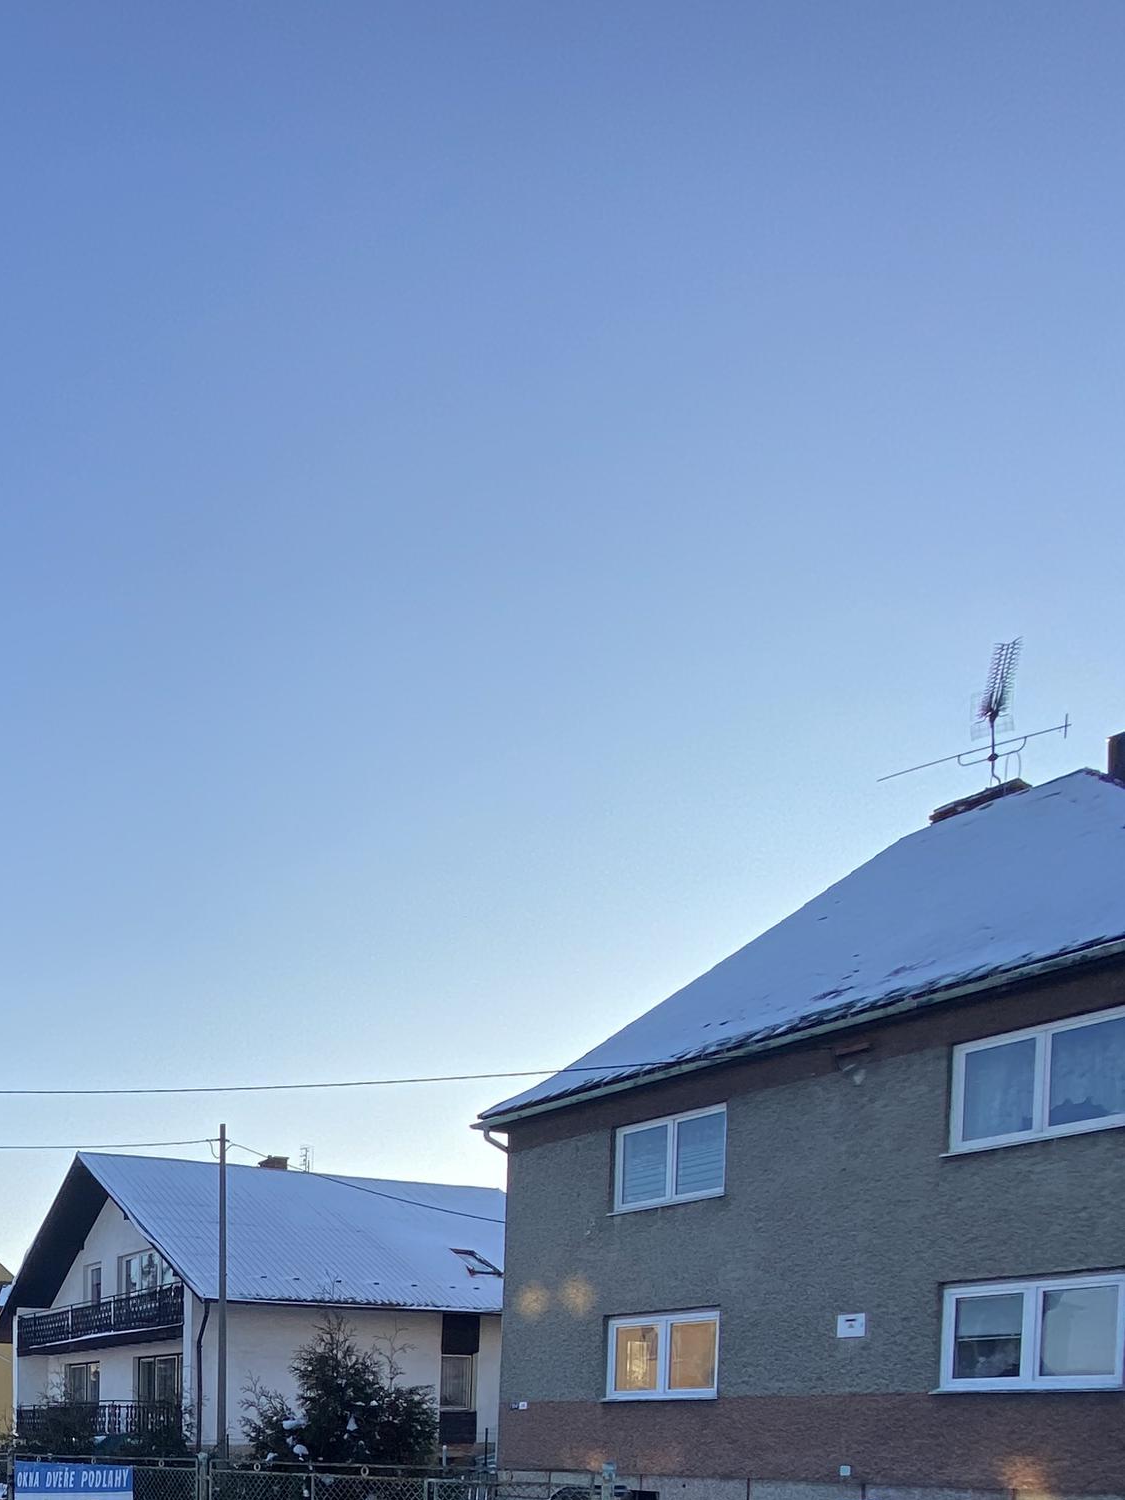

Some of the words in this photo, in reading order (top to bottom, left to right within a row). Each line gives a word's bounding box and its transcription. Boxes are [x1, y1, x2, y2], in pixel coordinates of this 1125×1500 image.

[16, 1471, 40, 1488] OKNA
[45, 1468, 75, 1488] DVEŘE
[80, 1469, 129, 1488] PODLAHY
